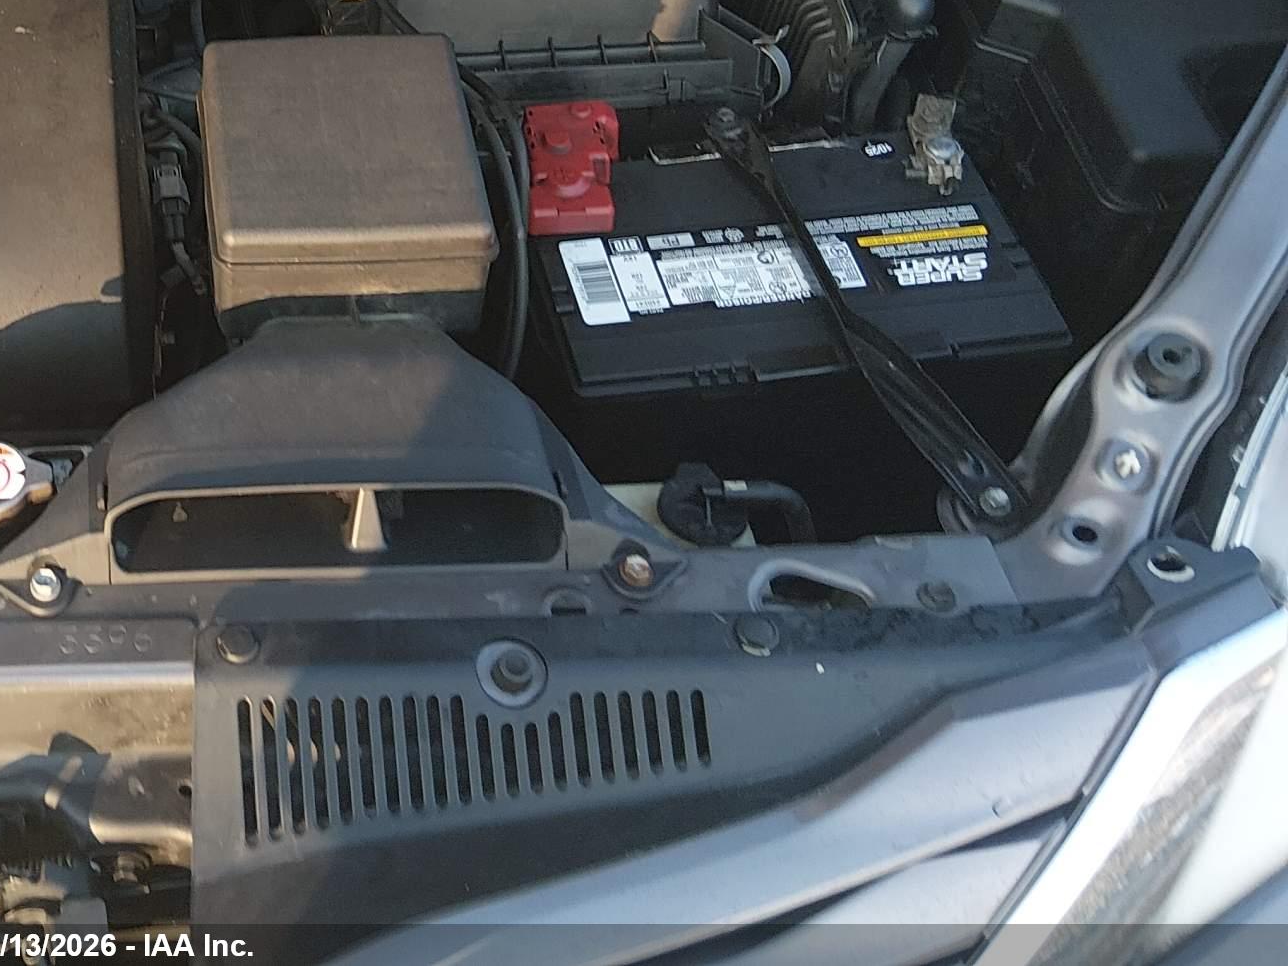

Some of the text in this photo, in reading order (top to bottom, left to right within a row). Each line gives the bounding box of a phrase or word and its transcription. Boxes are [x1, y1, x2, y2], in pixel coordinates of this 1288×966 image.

[662, 233, 681, 247] Pb
[895, 251, 989, 276] START
[894, 265, 984, 287] SUPER
